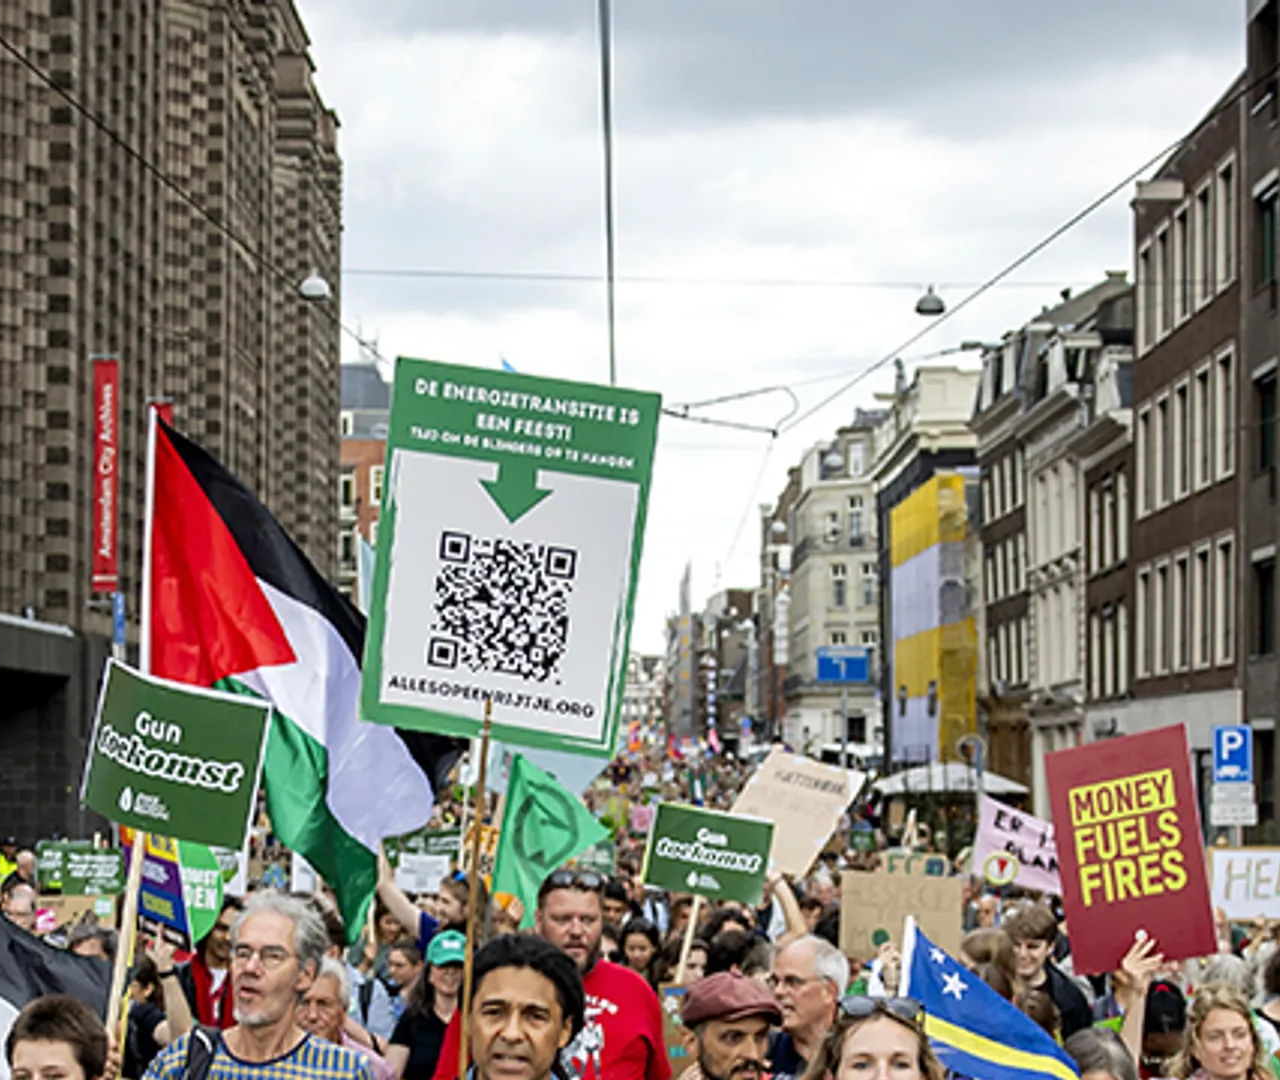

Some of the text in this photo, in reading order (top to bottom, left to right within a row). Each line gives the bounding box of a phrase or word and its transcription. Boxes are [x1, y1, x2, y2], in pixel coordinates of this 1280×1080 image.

[415, 377, 640, 426] DE ENERGIETRANSITIE IS
[476, 413, 510, 432] EEN
[99, 446, 115, 475] City
[389, 675, 596, 718] ALLESOPEENRIJTJE.ORG
[135, 711, 183, 745] Gun
[1221, 731, 1244, 760] P
[97, 724, 245, 793] toekomst
[1072, 772, 1170, 822] MONEY
[994, 809, 1024, 833] ER
[1074, 810, 1181, 865] FUELS
[656, 836, 762, 875] toekomst
[1078, 849, 1188, 907] FIRES
